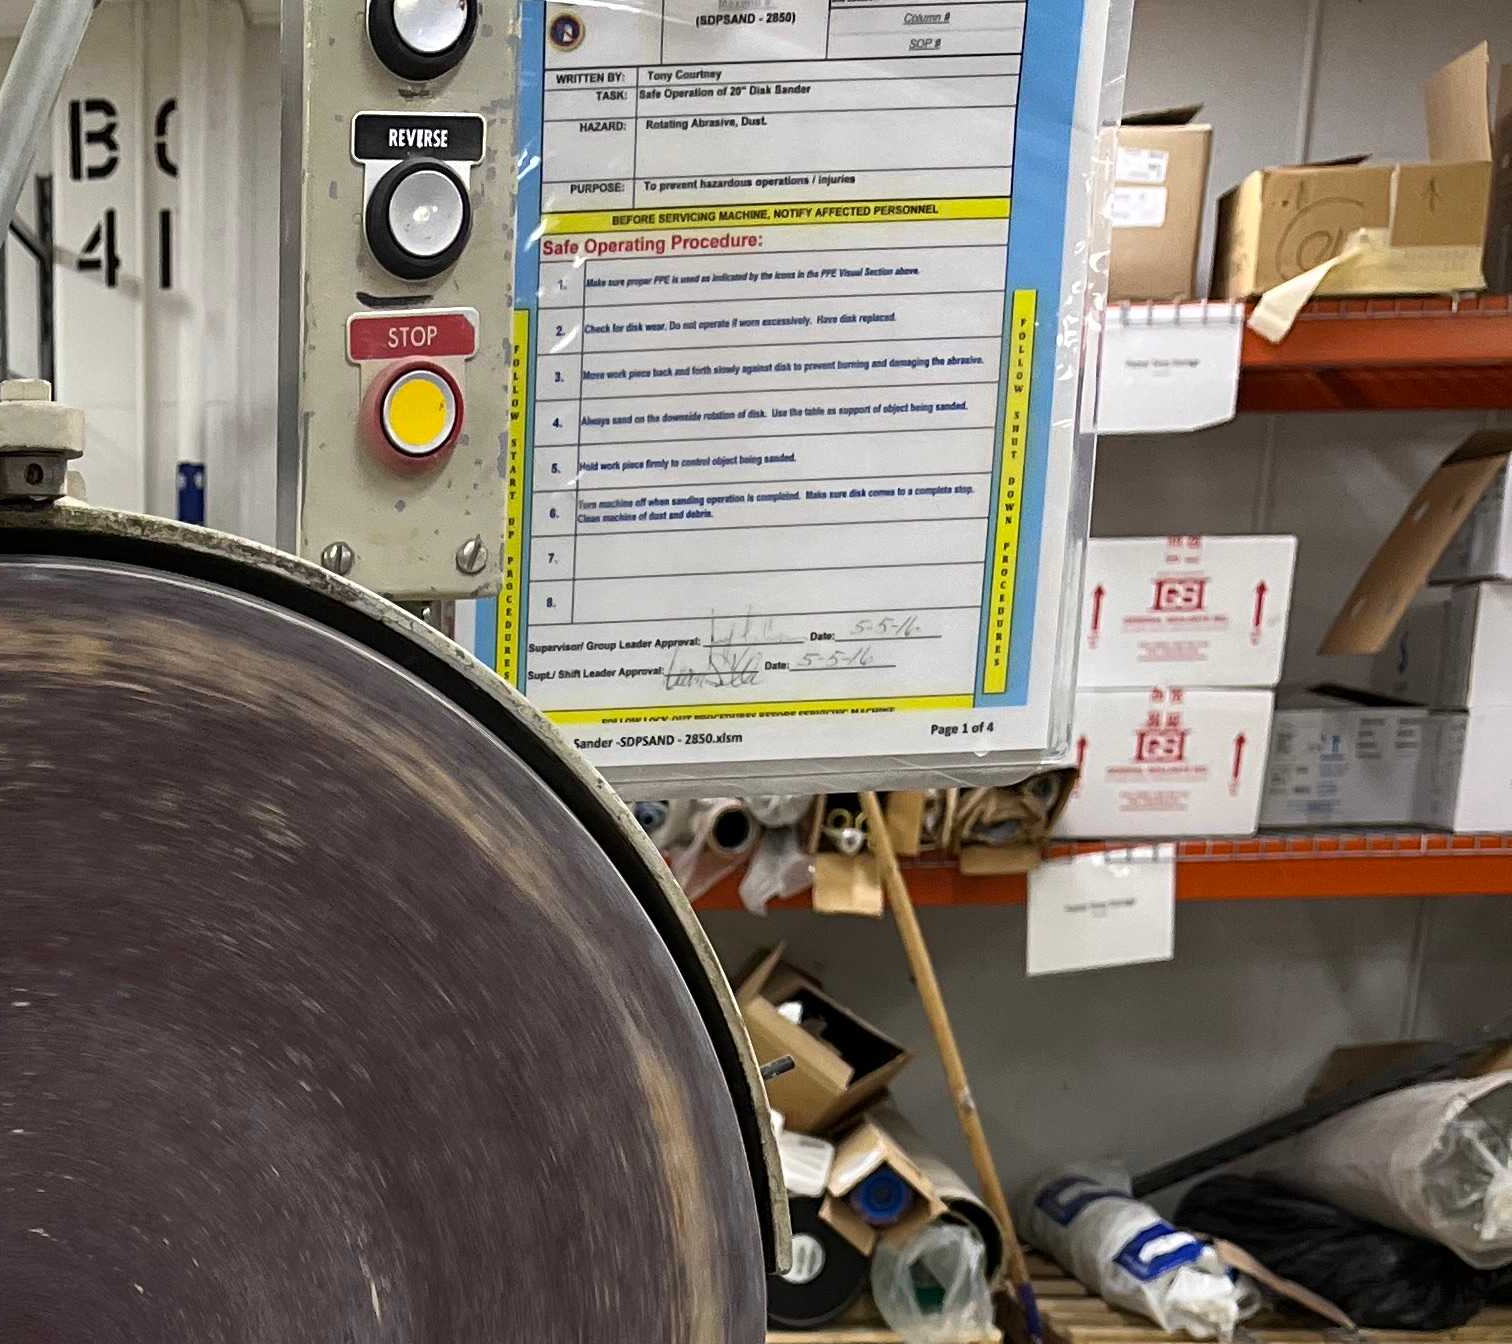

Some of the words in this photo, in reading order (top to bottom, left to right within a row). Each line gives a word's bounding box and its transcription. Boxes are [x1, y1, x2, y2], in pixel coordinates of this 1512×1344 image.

[766, 13, 795, 24] 2850)
[909, 39, 931, 50] SOP
[556, 73, 604, 84] WRITTEN
[607, 73, 625, 82] BY:
[648, 71, 671, 82] Tony
[675, 70, 722, 81] Courtney
[596, 91, 627, 101] TASK:
[639, 90, 661, 99] Safe
[664, 88, 714, 99] Operation
[717, 87, 727, 96] of
[749, 85, 772, 95] Disk
[775, 85, 811, 94] Sander
[580, 121, 626, 132] HAZARD:
[646, 119, 688, 130] Rotating
[691, 117, 738, 128] Abrasive,
[741, 117, 767, 126] Dust.
[389, 128, 448, 148] REVERSE
[570, 183, 625, 194] PURPOSE:
[644, 181, 656, 191] To
[659, 180, 697, 192] prevent
[700, 178, 752, 189] hazardous
[756, 176, 809, 187] operations
[818, 175, 855, 186] injuries
[612, 215, 655, 225] BEFORE
[659, 212, 715, 223] SERVICING
[719, 210, 770, 222] MACHINE,
[774, 208, 812, 218] NOTIFY
[815, 206, 871, 217] AFFECTED
[874, 205, 938, 215] PERSONNEL
[543, 240, 578, 255] Safe
[585, 236, 665, 254] Operating
[671, 233, 763, 250] Procedure:
[556, 326, 565, 336] 2.
[585, 324, 610, 334] Check
[626, 322, 643, 332] disk
[670, 321, 680, 330] Do
[699, 319, 729, 331] operate
[740, 318, 760, 327] worn
[817, 314, 837, 324] Have
[840, 313, 856, 323] disk
[388, 326, 437, 348] STOP
[555, 373, 564, 383] 3.
[607, 369, 626, 378] work
[653, 367, 672, 377] back
[742, 363, 772, 374] against
[804, 361, 835, 372] prevent
[932, 356, 944, 366] the
[553, 418, 562, 428] 4.
[772, 408, 787, 418] Use
[790, 407, 802, 417] the
[805, 406, 824, 416] table
[839, 405, 870, 416] support
[884, 403, 908, 415] object
[911, 402, 933, 414] being
[552, 464, 560, 473] 5.
[601, 461, 620, 470] work
[622, 460, 644, 471] piece
[646, 458, 668, 470] firmly
[681, 457, 710, 467] control
[712, 455, 737, 467] object
[740, 455, 762, 465] being
[550, 508, 559, 518] 6.
[707, 493, 745, 505] operation
[849, 488, 866, 498] disk
[915, 485, 952, 497] complete
[603, 512, 636, 522] machine
[669, 510, 684, 519] and
[548, 553, 558, 564] 7.
[994, 542, 1010, 667] PROCEDURES
[586, 641, 616, 652] Group
[619, 639, 651, 649] Leader
[655, 637, 701, 648] Approval:
[810, 632, 835, 641] Date:
[559, 669, 580, 679] Shift
[583, 668, 615, 678] Leader
[619, 666, 664, 677] Approval:
[765, 661, 789, 670] Date:
[931, 724, 958, 736] Page
[963, 723, 968, 733] 1
[971, 722, 984, 732] of
[986, 722, 994, 732] 4
[574, 738, 612, 749] Sander
[685, 733, 742, 745] 2850.xlsm
